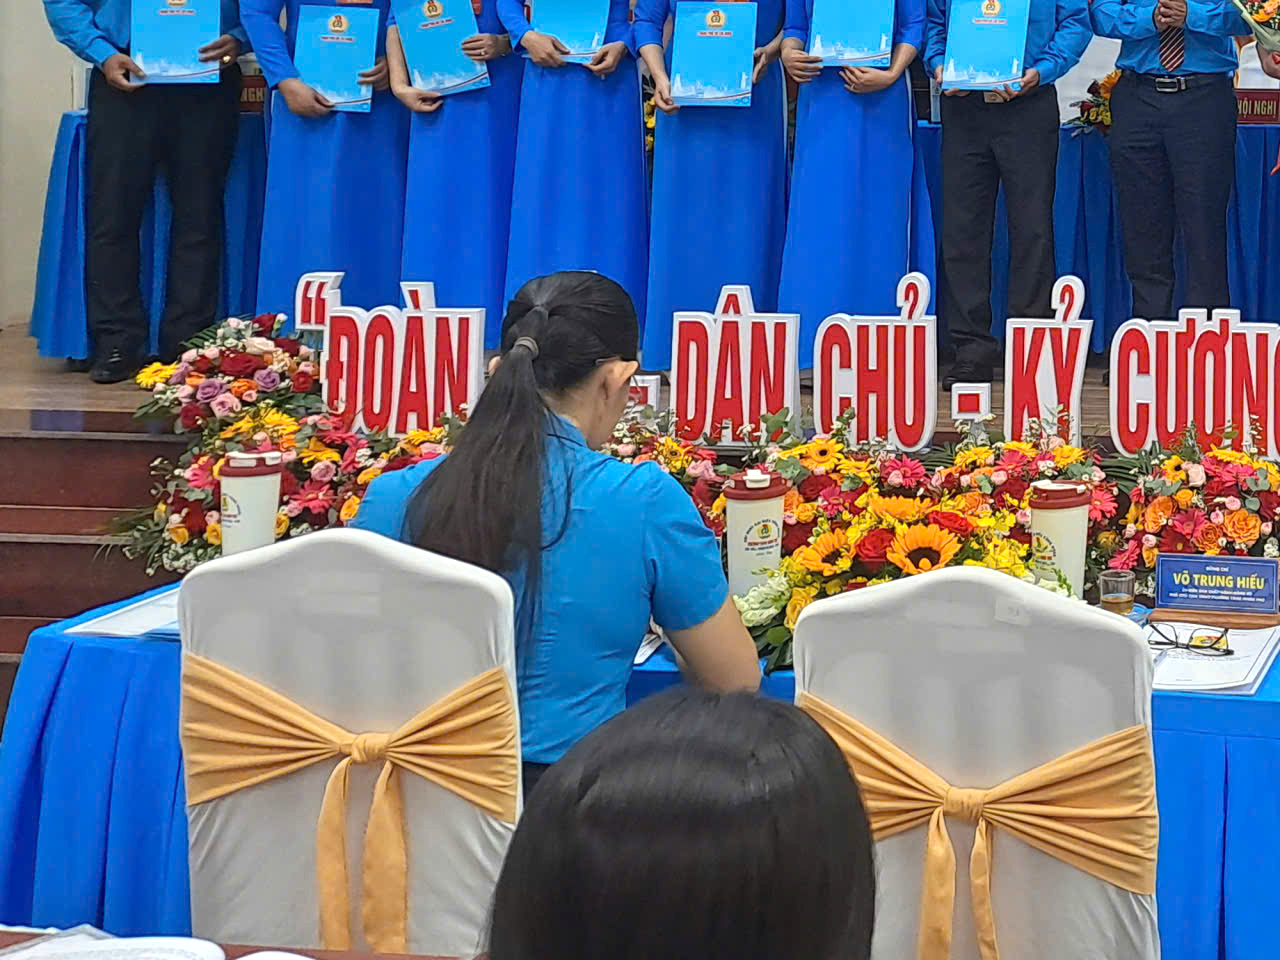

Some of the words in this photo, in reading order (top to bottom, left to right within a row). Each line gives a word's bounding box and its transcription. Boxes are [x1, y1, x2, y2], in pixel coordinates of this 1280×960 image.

[1254, 100, 1277, 118] NGHỊ
[676, 294, 786, 441] DÂN
[821, 282, 922, 443] CHỦ
[1012, 284, 1088, 446] KỶ
[1173, 570, 1191, 585] VÕ
[1193, 574, 1234, 588] TRUNG
[1237, 573, 1265, 590] HIẾU
